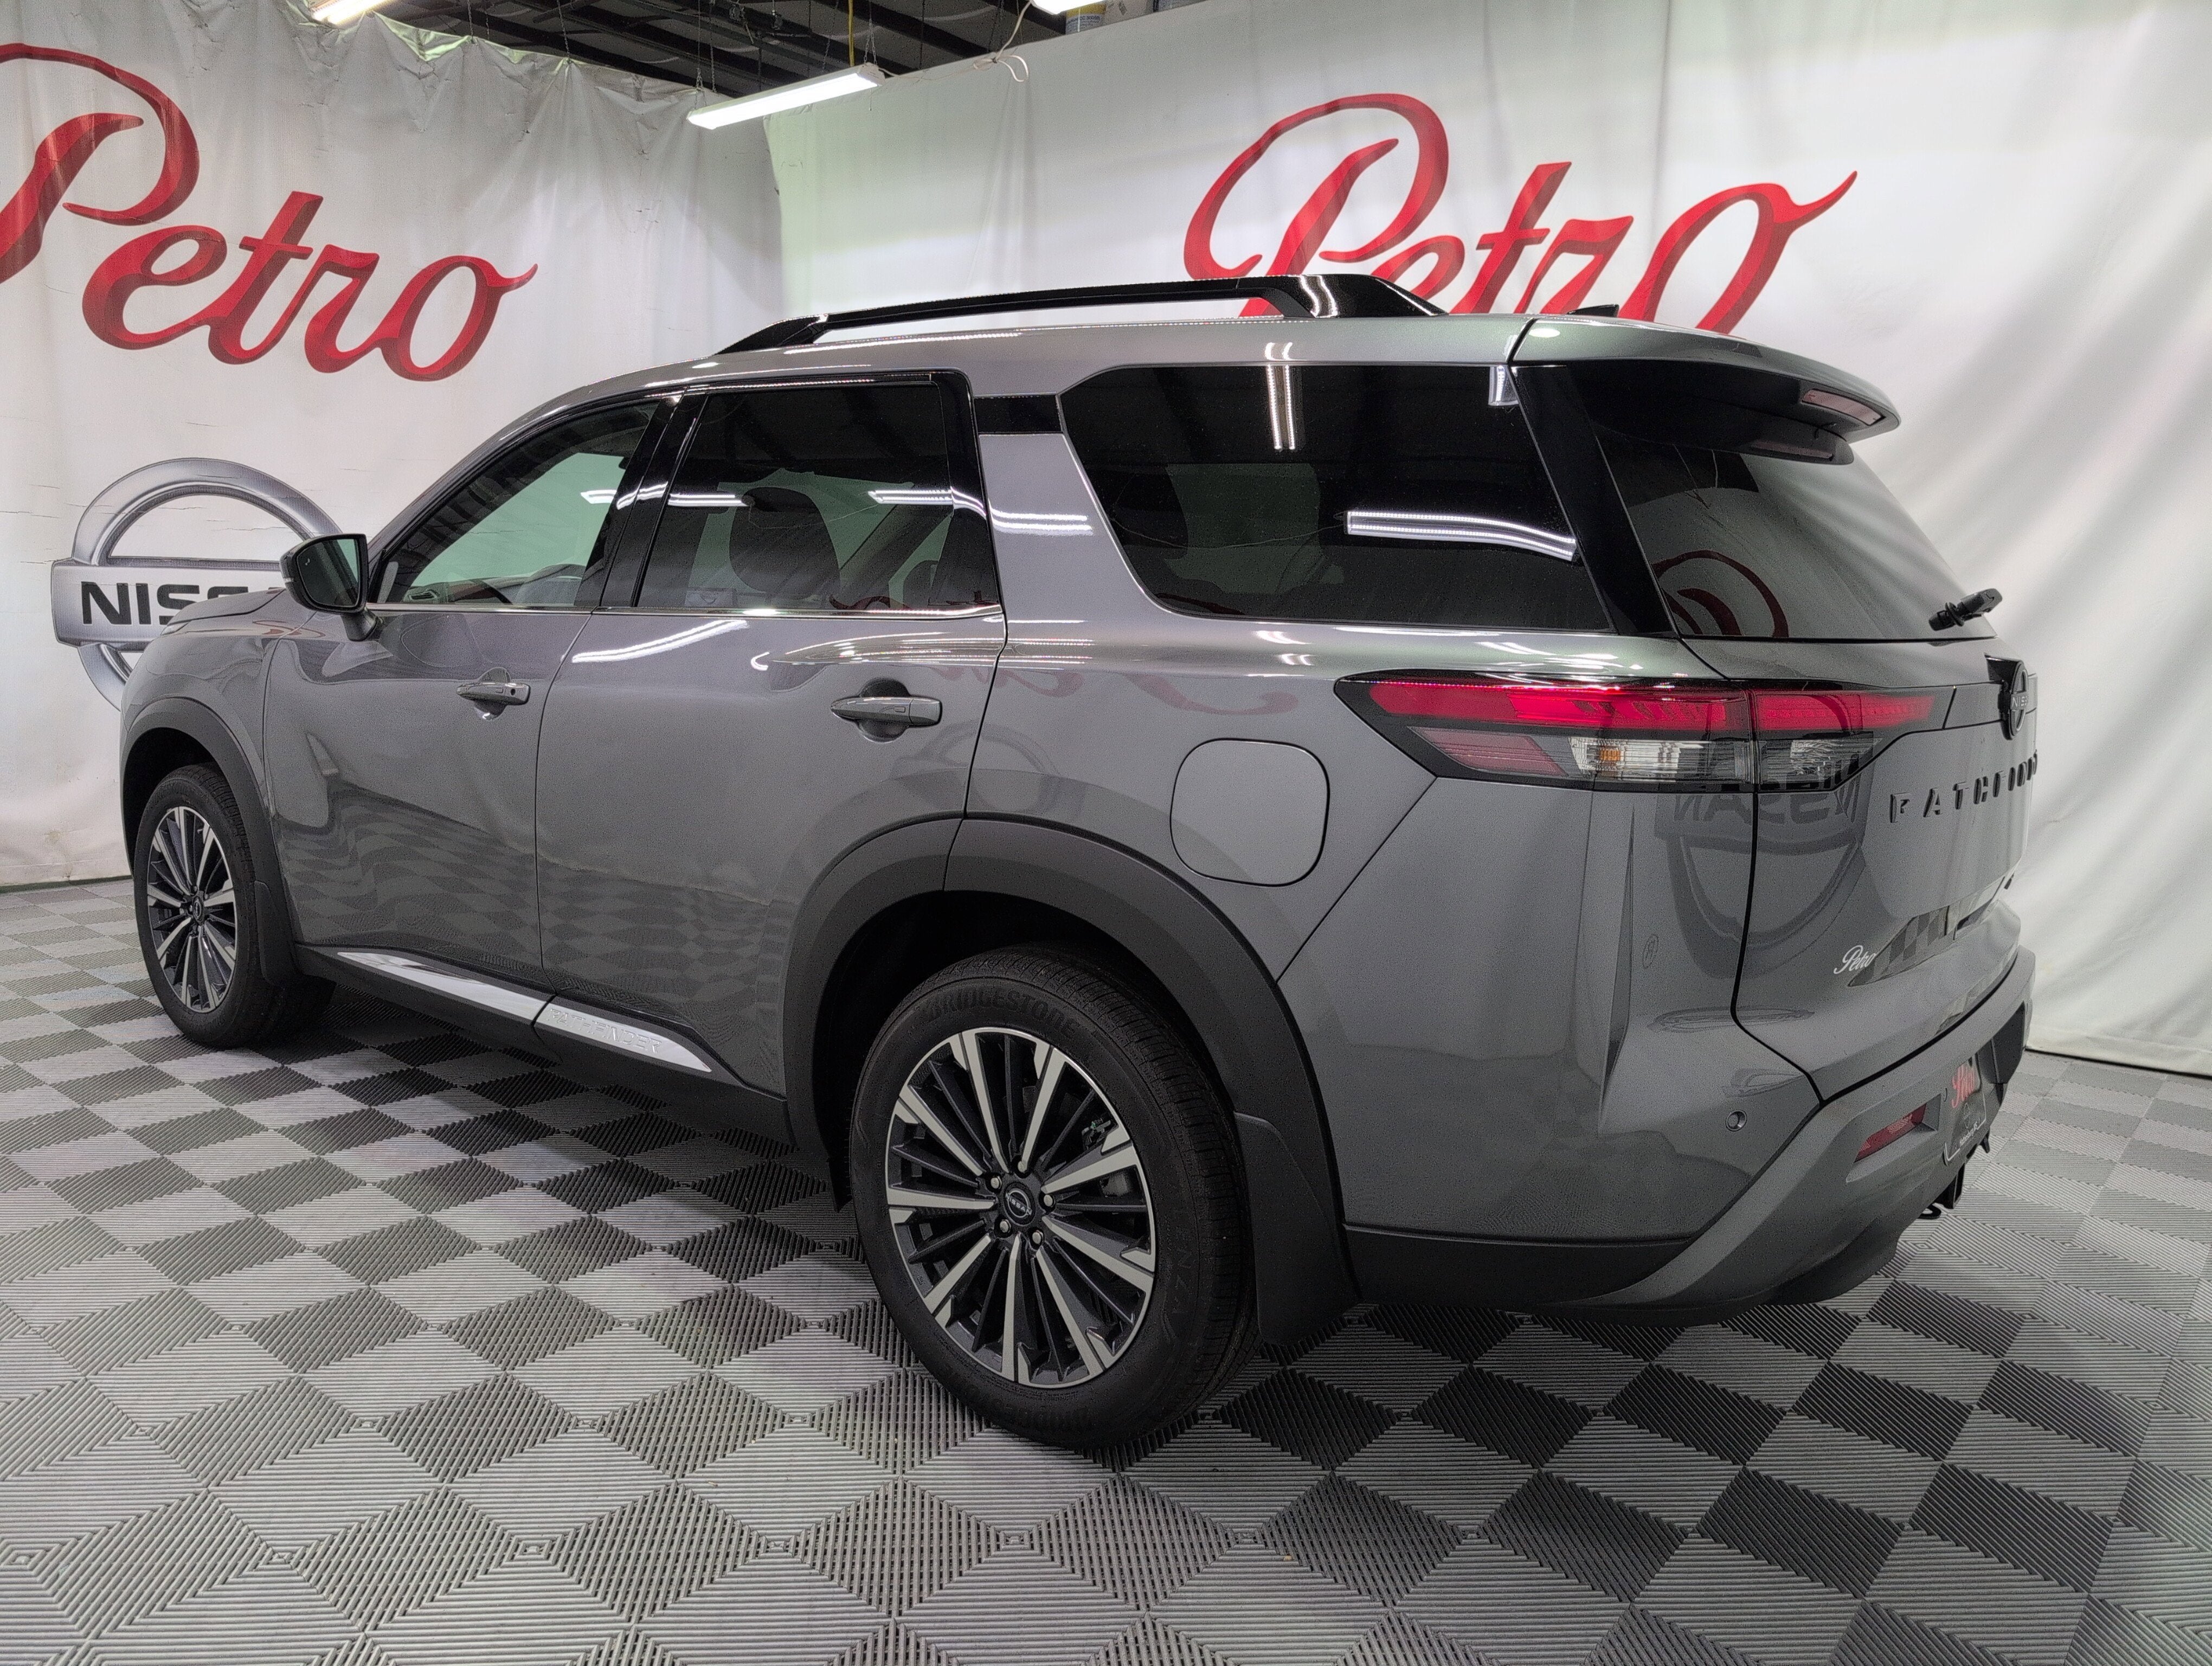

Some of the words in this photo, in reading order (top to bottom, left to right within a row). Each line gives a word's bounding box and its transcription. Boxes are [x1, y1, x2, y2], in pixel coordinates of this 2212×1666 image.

[0, 43, 538, 381] Petro
[1834, 945, 1876, 974] Petro
[545, 1008, 663, 1054] PATHFINDER
[1005, 1193, 1033, 1215] NISSAN
